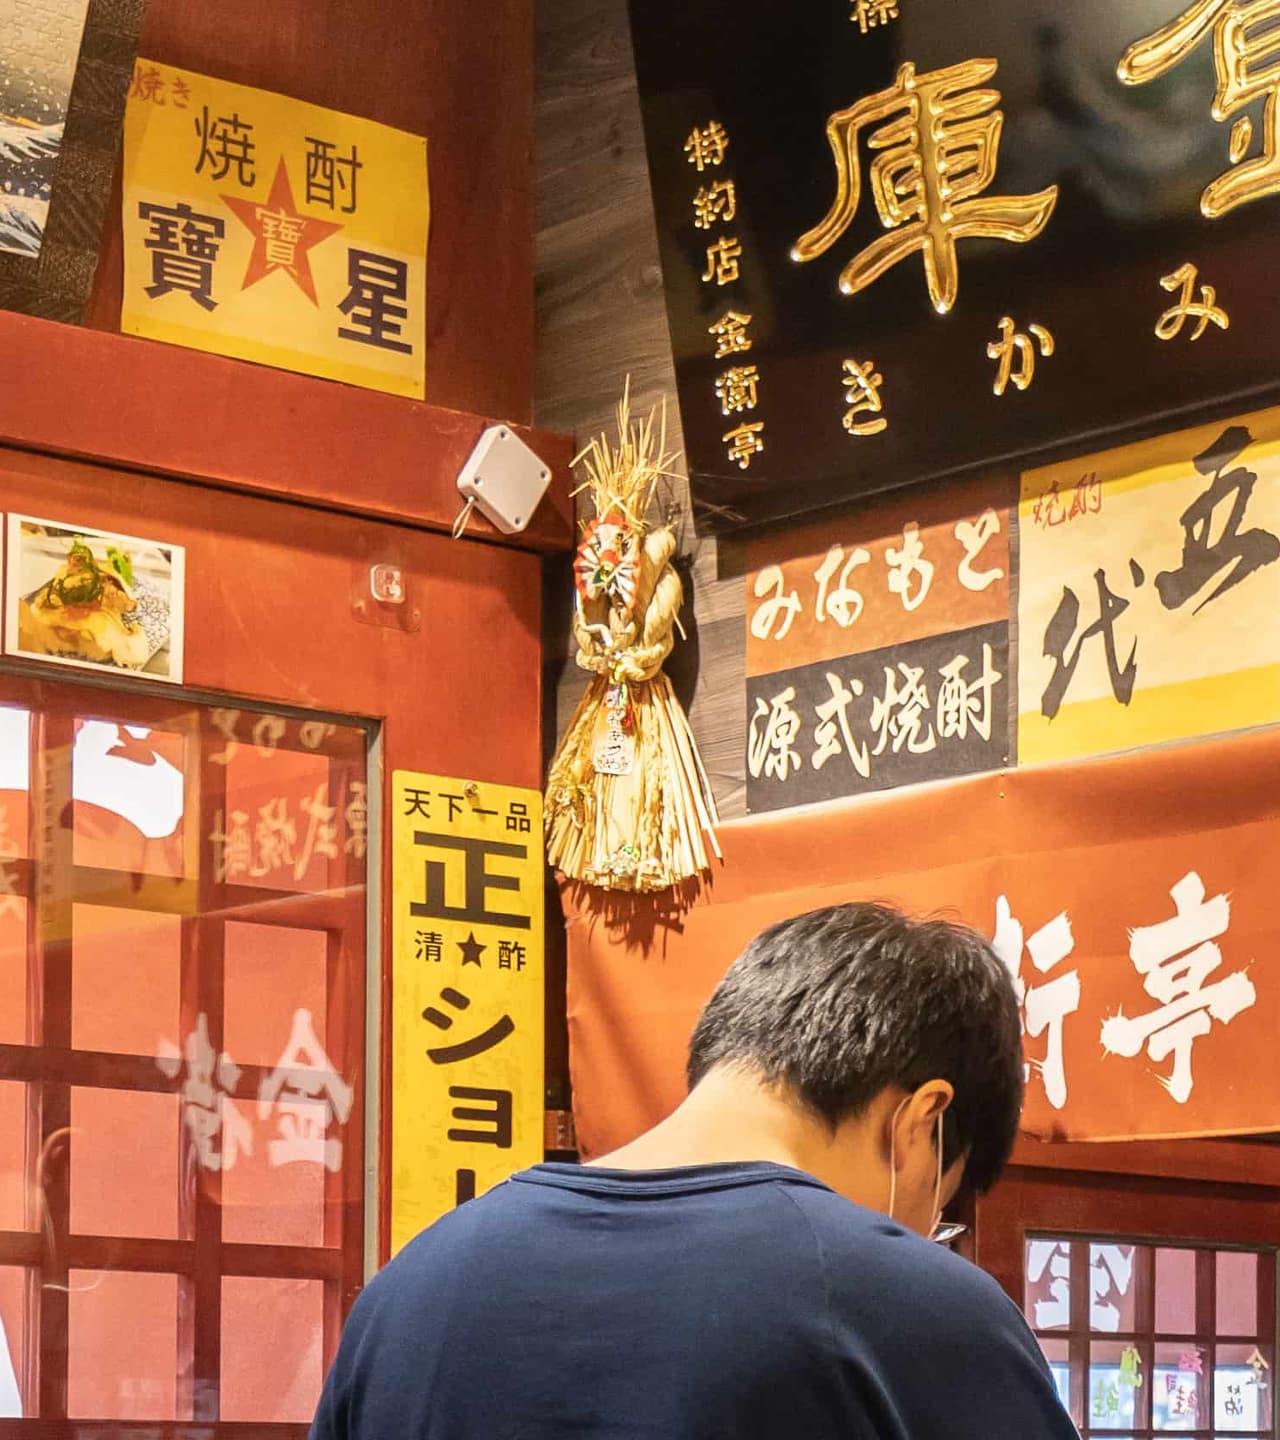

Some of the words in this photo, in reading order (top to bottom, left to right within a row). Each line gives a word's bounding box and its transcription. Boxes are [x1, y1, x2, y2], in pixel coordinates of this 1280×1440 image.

[193, 105, 363, 213] 焼酎
[751, 507, 1004, 642] みなもと
[404, 787, 531, 833] 天下一品
[409, 830, 531, 929] 正
